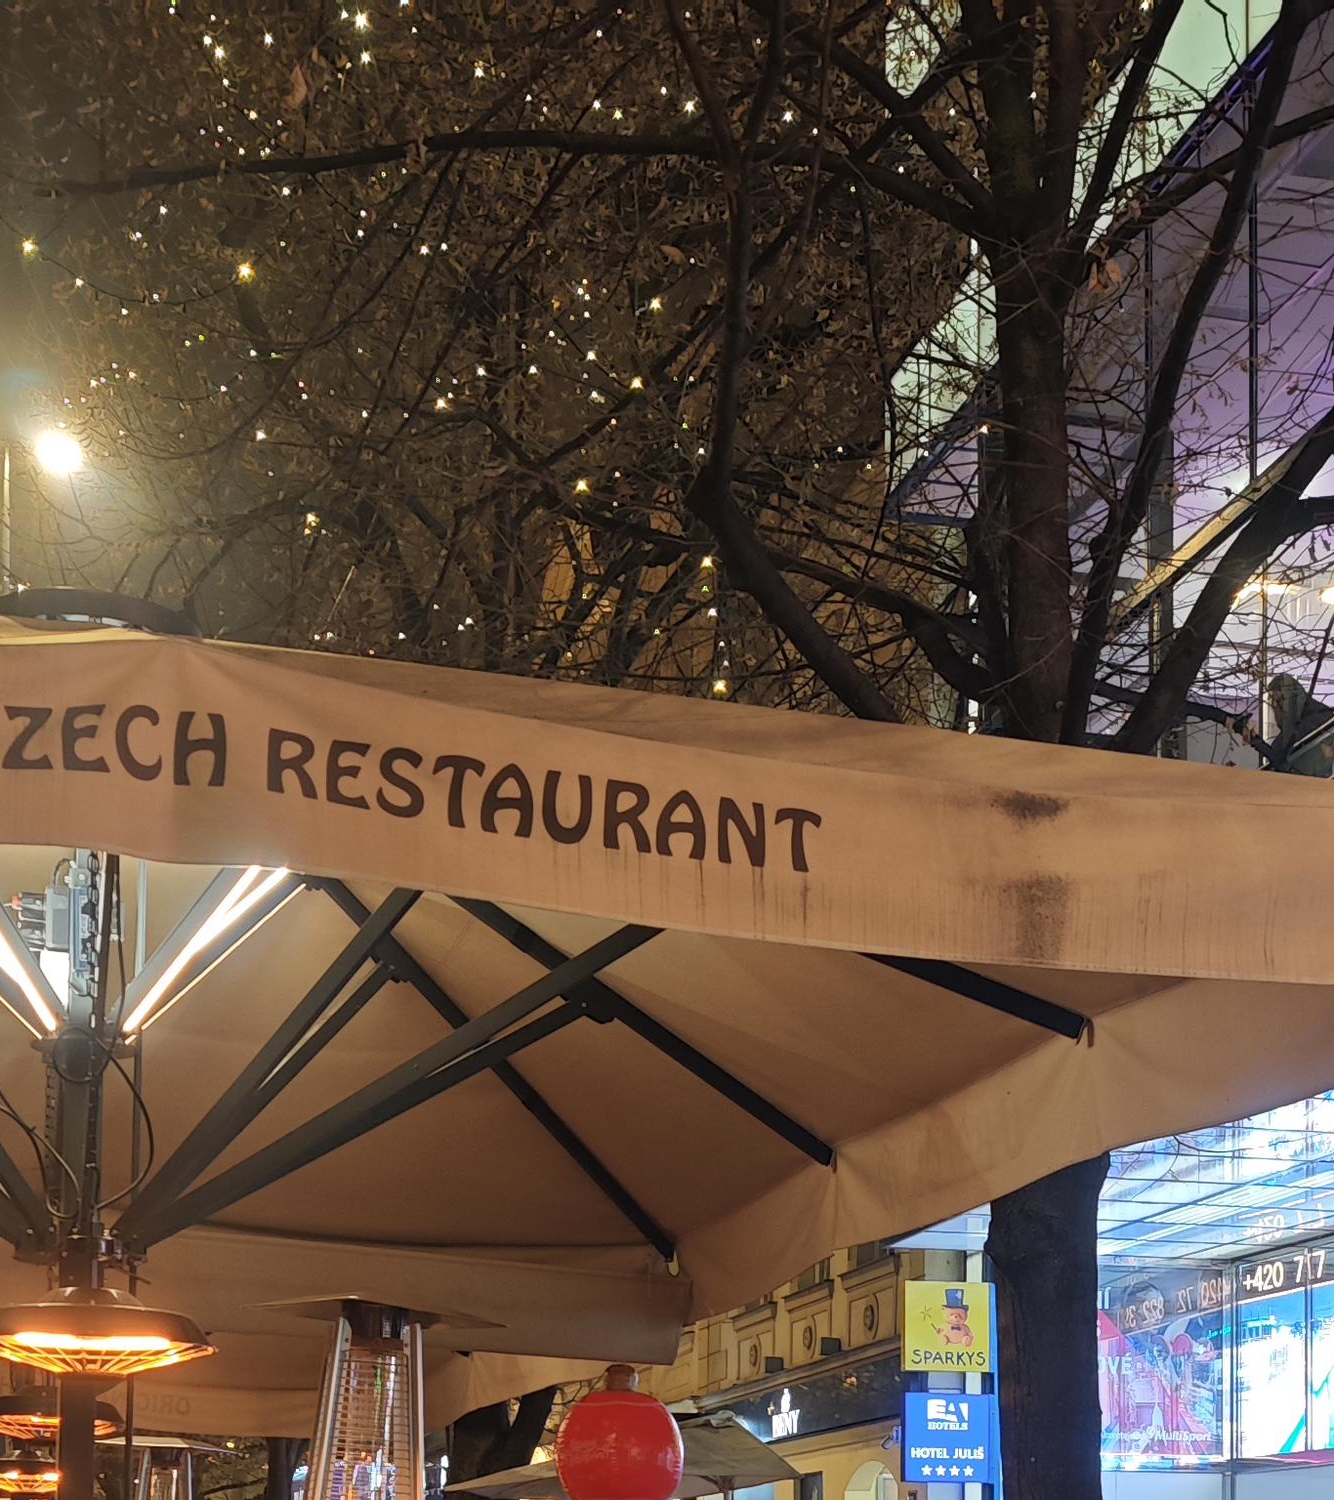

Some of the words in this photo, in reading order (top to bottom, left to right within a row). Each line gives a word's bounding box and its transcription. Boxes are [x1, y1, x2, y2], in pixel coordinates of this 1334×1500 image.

[267, 729, 823, 872] RESTAURANT
[1243, 1261, 1284, 1292] +420
[911, 1349, 986, 1367] SPARKYS
[927, 1421, 969, 1431] HOTELS
[1154, 1429, 1212, 1442] MultiSport
[910, 1446, 949, 1460] HOTEL
[953, 1445, 985, 1460] JULIŠ
